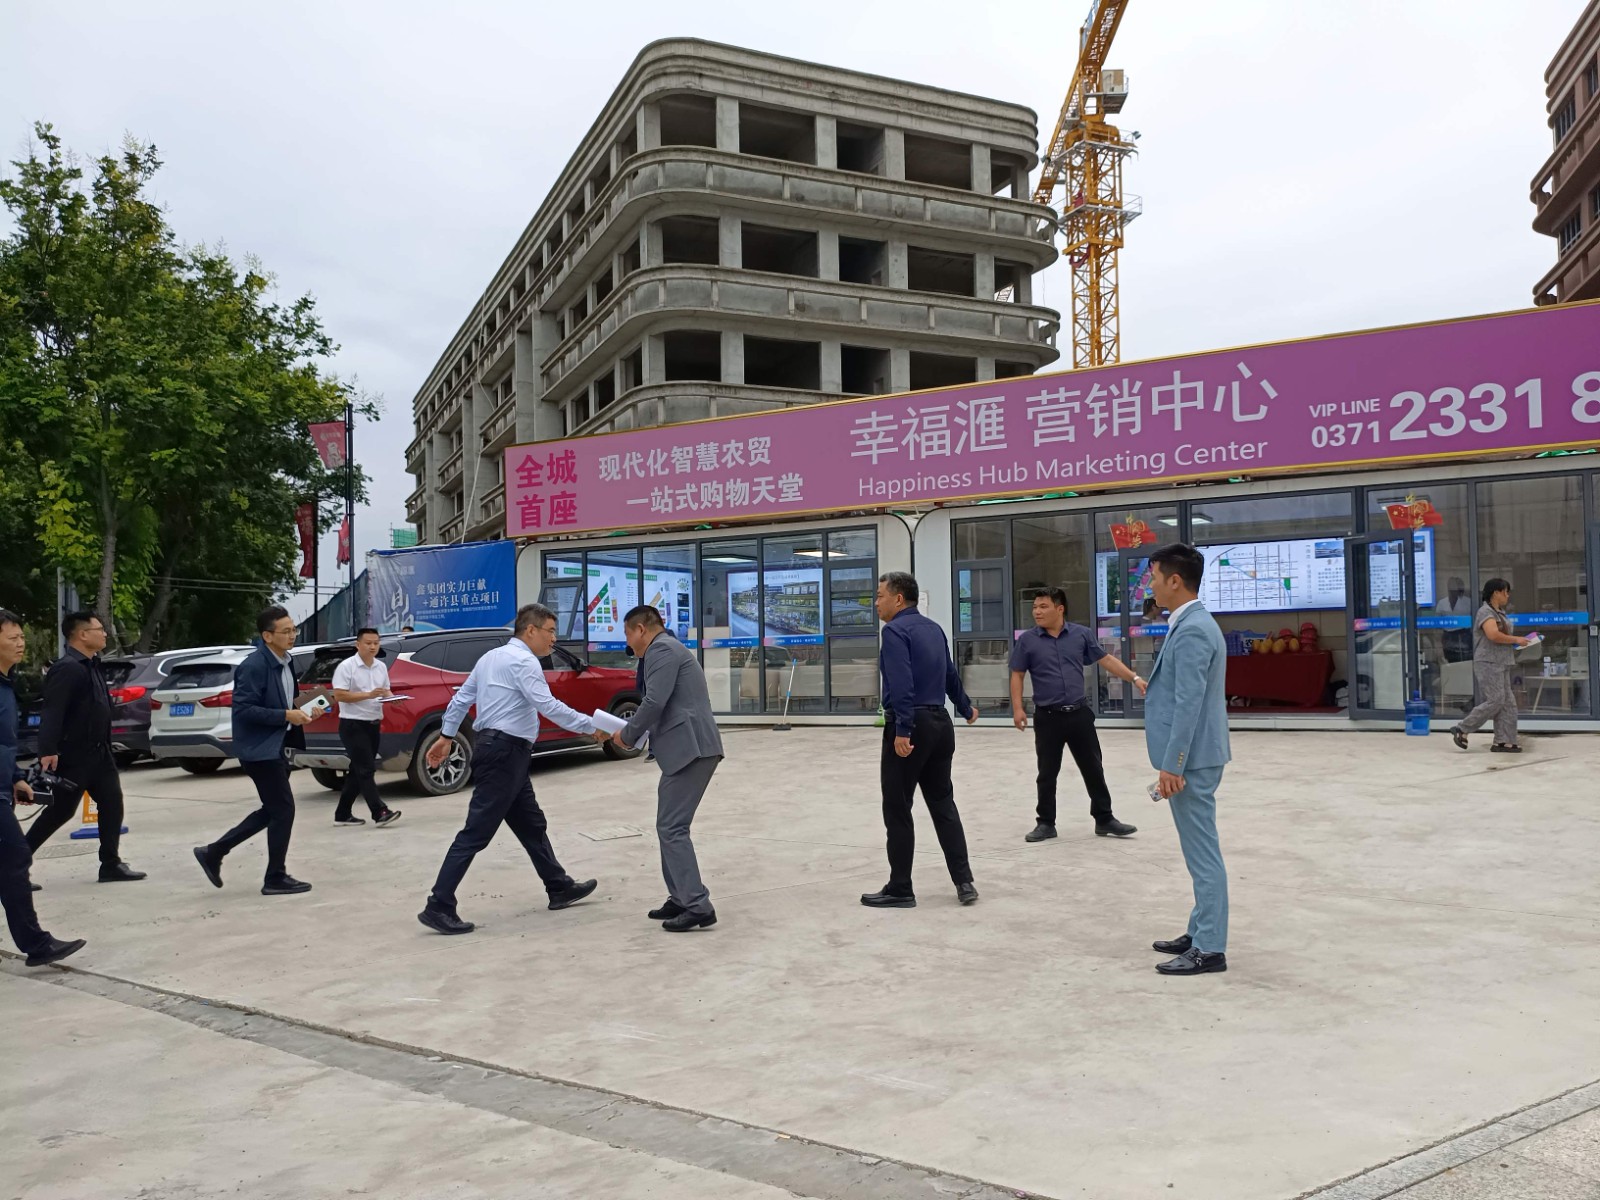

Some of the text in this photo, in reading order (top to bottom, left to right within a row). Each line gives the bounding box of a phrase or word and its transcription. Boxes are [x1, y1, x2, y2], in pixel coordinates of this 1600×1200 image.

[1026, 361, 1278, 447] 营销中心
[1309, 398, 1381, 418] VIP LINE
[1311, 370, 1600, 448] 0371 2331 8
[515, 449, 578, 490] 全城
[598, 436, 772, 483] 现代化智慧农贸
[858, 441, 1268, 500] Happiness Hub Marketing Center
[515, 490, 578, 530] 首座
[626, 472, 804, 514] 一站式购物天堂
